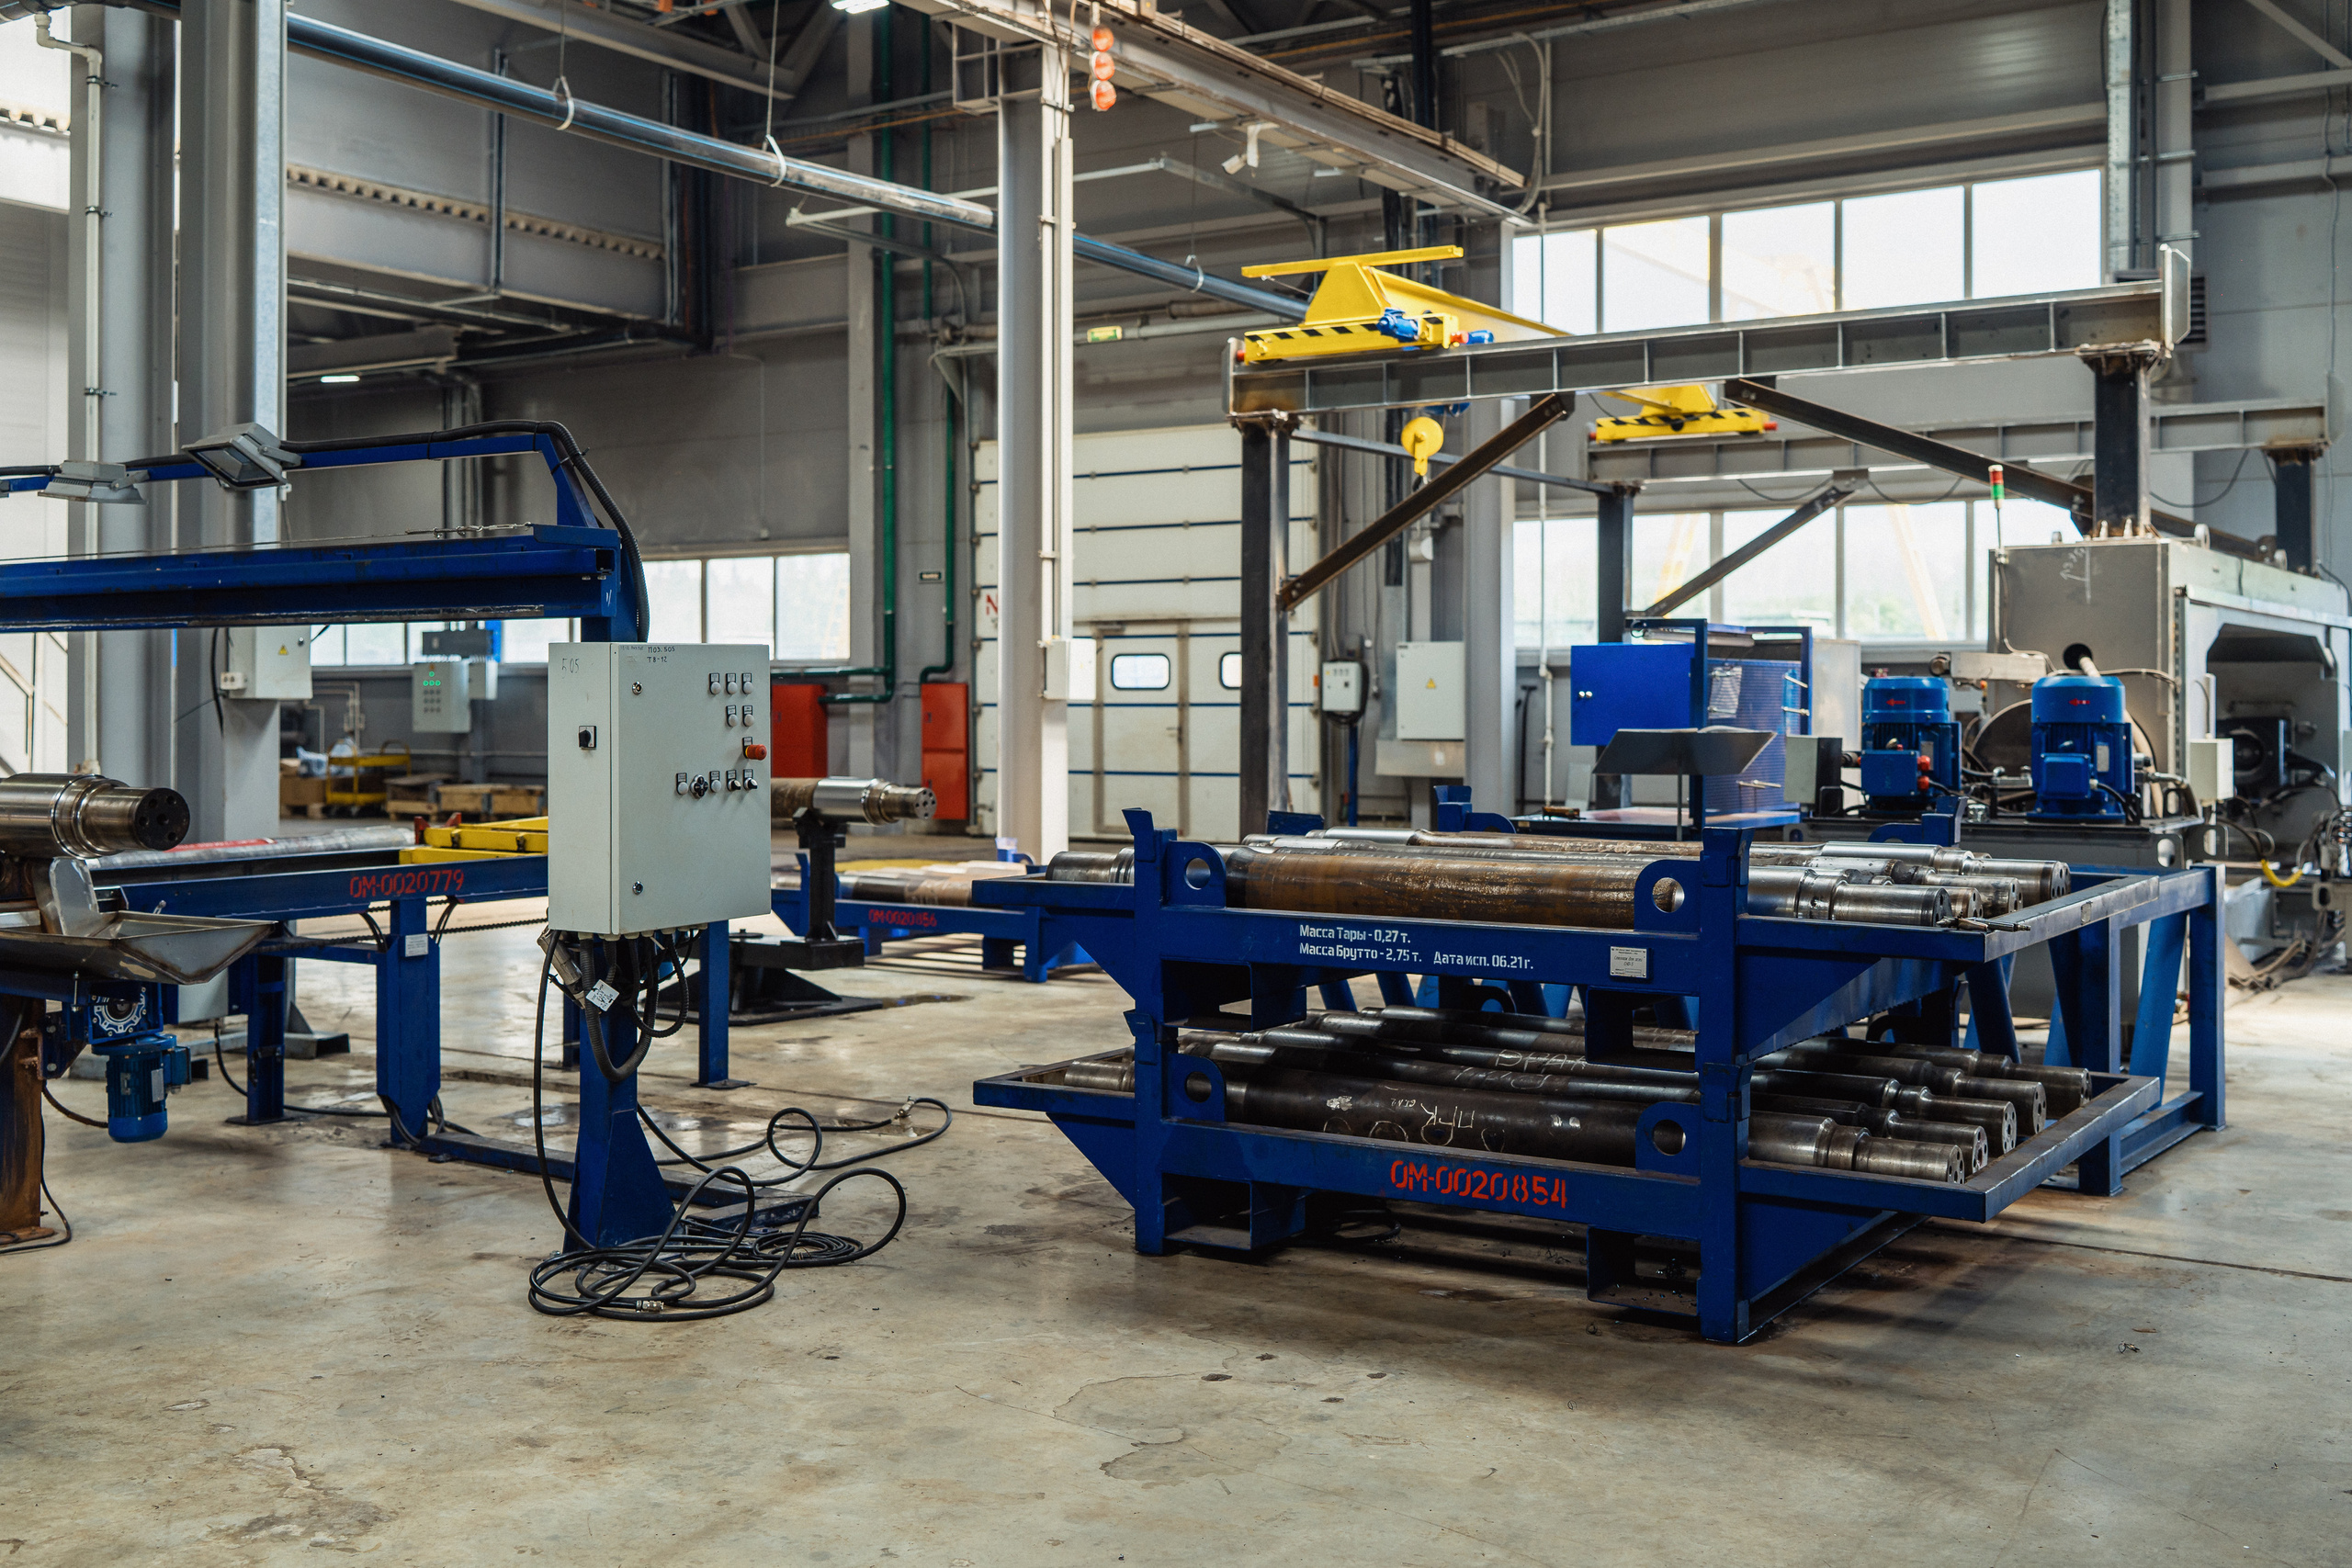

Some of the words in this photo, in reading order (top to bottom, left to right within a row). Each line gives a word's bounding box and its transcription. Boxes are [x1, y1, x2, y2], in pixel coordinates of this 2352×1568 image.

[1299, 924, 1335, 939] Масса
[1336, 927, 1366, 942] Тары
[1374, 929, 1399, 943] 0,27
[1400, 932, 1411, 943] т.
[1299, 942, 1335, 957] Масса
[1336, 944, 1378, 961] Брутто
[1385, 948, 1410, 962] 2,75
[1411, 952, 1422, 963] т.
[1433, 951, 1464, 965] Дата
[1464, 955, 1490, 967] исп.
[1390, 1160, 1567, 1208] ОМ-0020854
